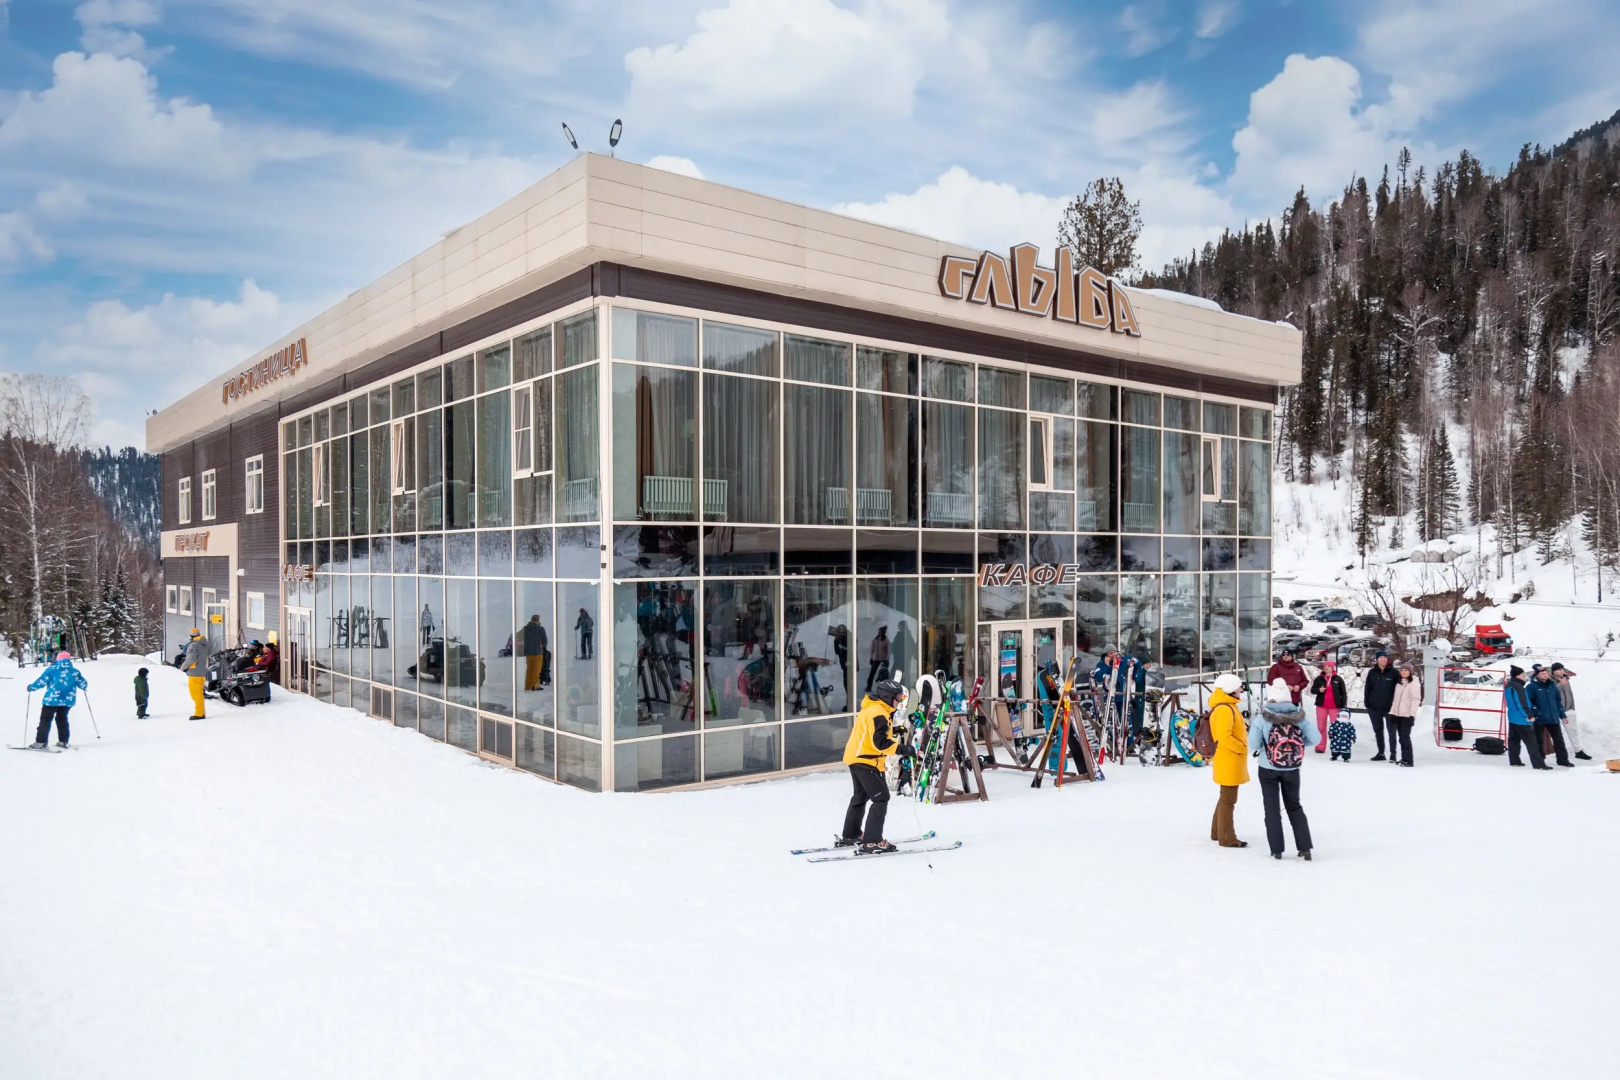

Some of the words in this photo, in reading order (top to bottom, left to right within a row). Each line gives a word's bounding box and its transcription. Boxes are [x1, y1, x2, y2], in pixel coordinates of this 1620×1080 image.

[938, 242, 1141, 337] ГЛЫБА
[222, 337, 308, 405] ГОСТИНИЦА
[175, 531, 210, 552] ПРОКАТ
[280, 563, 314, 582] КАФЕ
[978, 563, 1080, 587] КАФЕ
